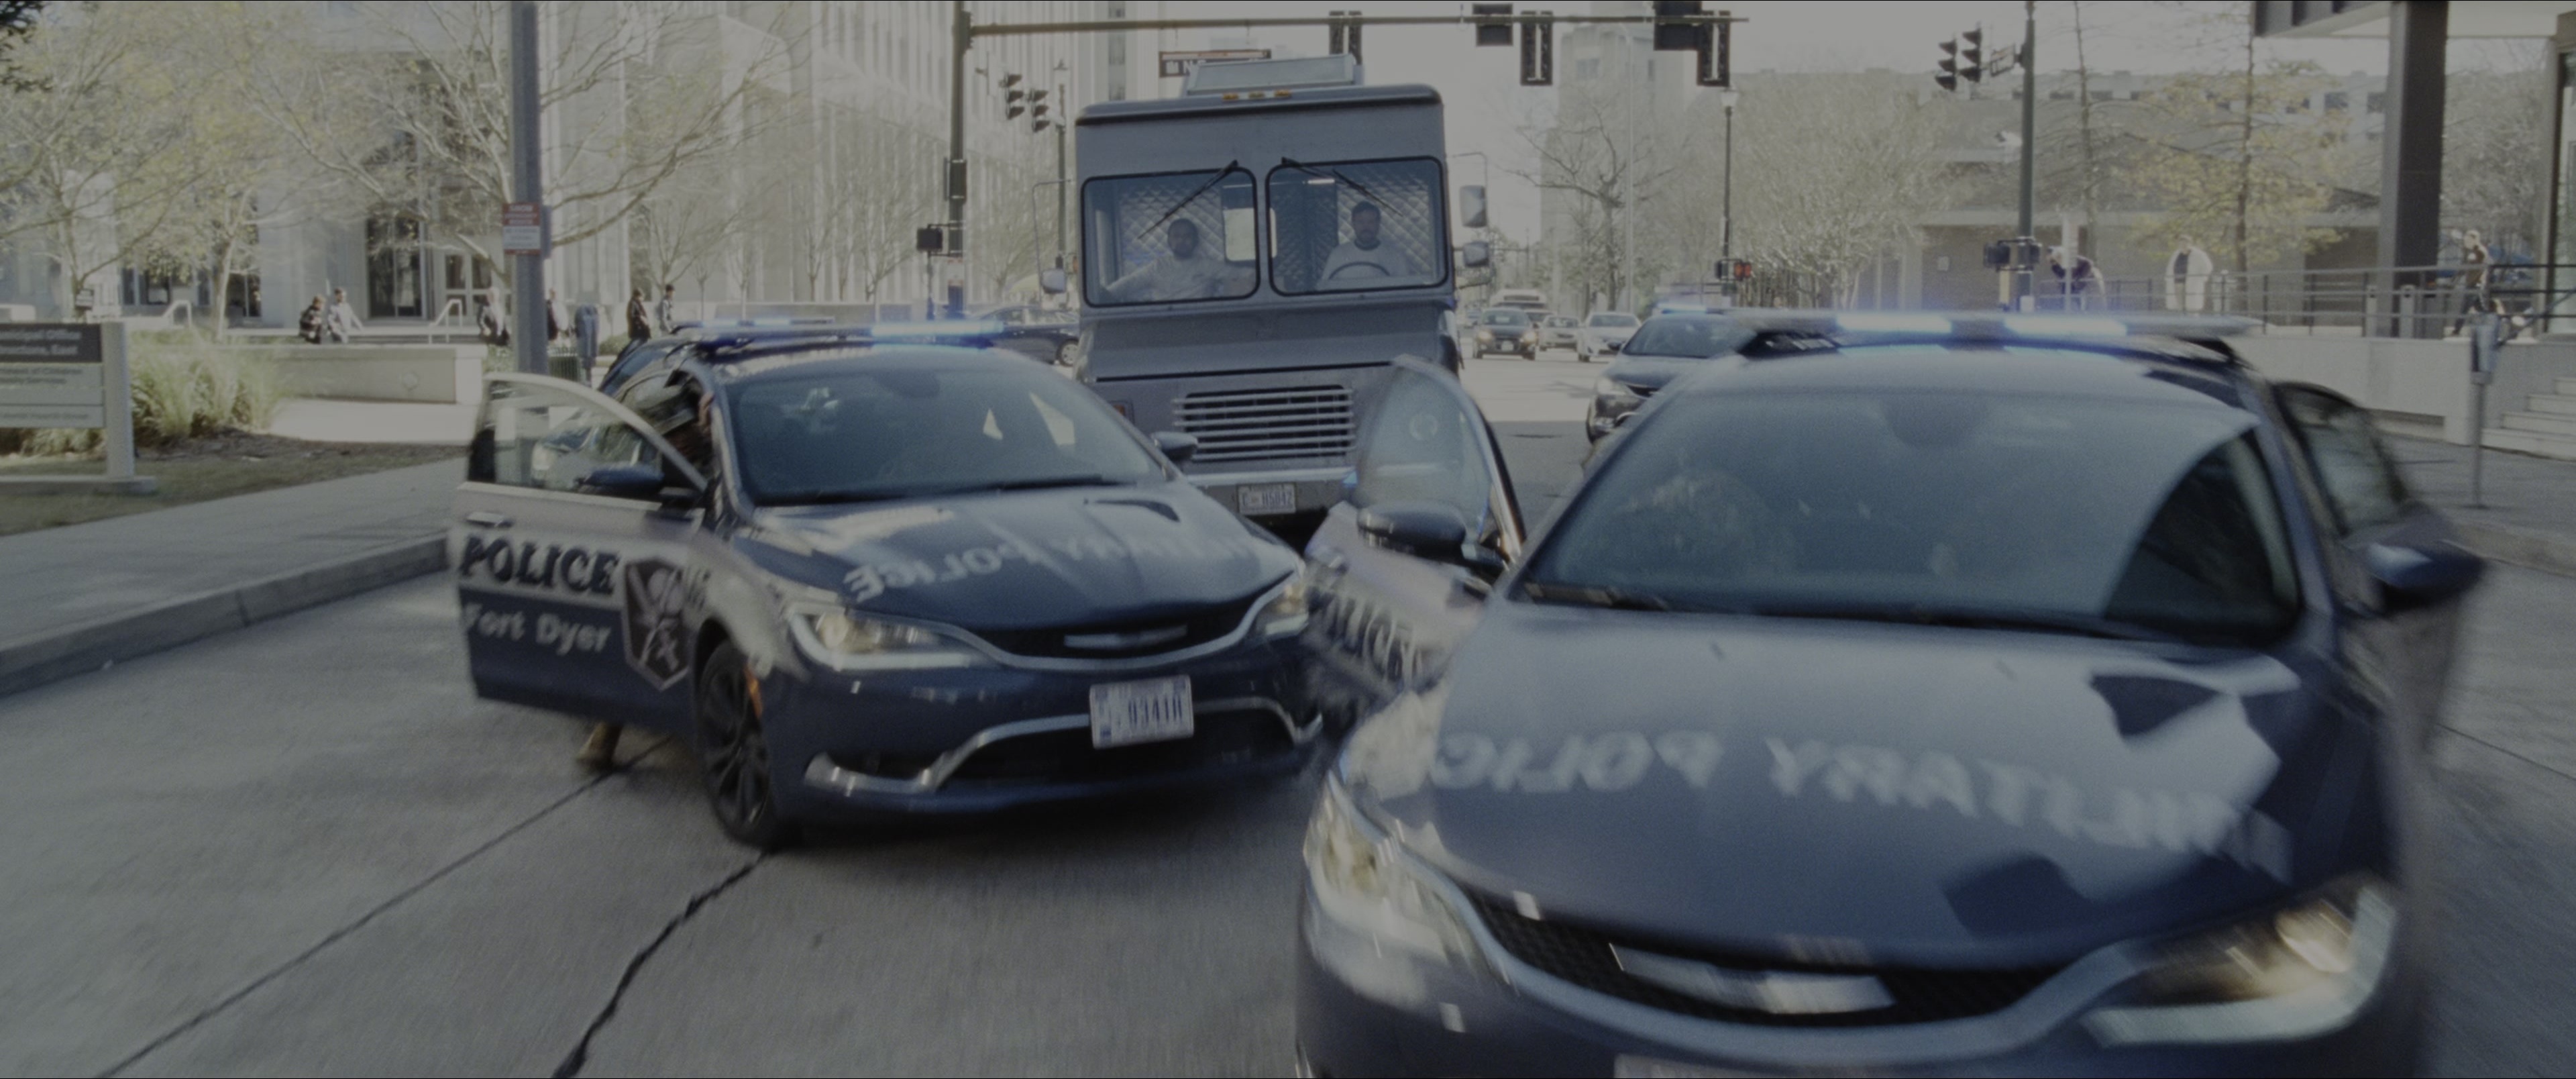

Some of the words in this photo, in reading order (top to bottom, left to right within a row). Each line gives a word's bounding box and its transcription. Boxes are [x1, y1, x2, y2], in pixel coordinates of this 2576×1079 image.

[459, 535, 620, 596] POLICE
[464, 604, 526, 641] Fort
[536, 613, 612, 656] Dyer
